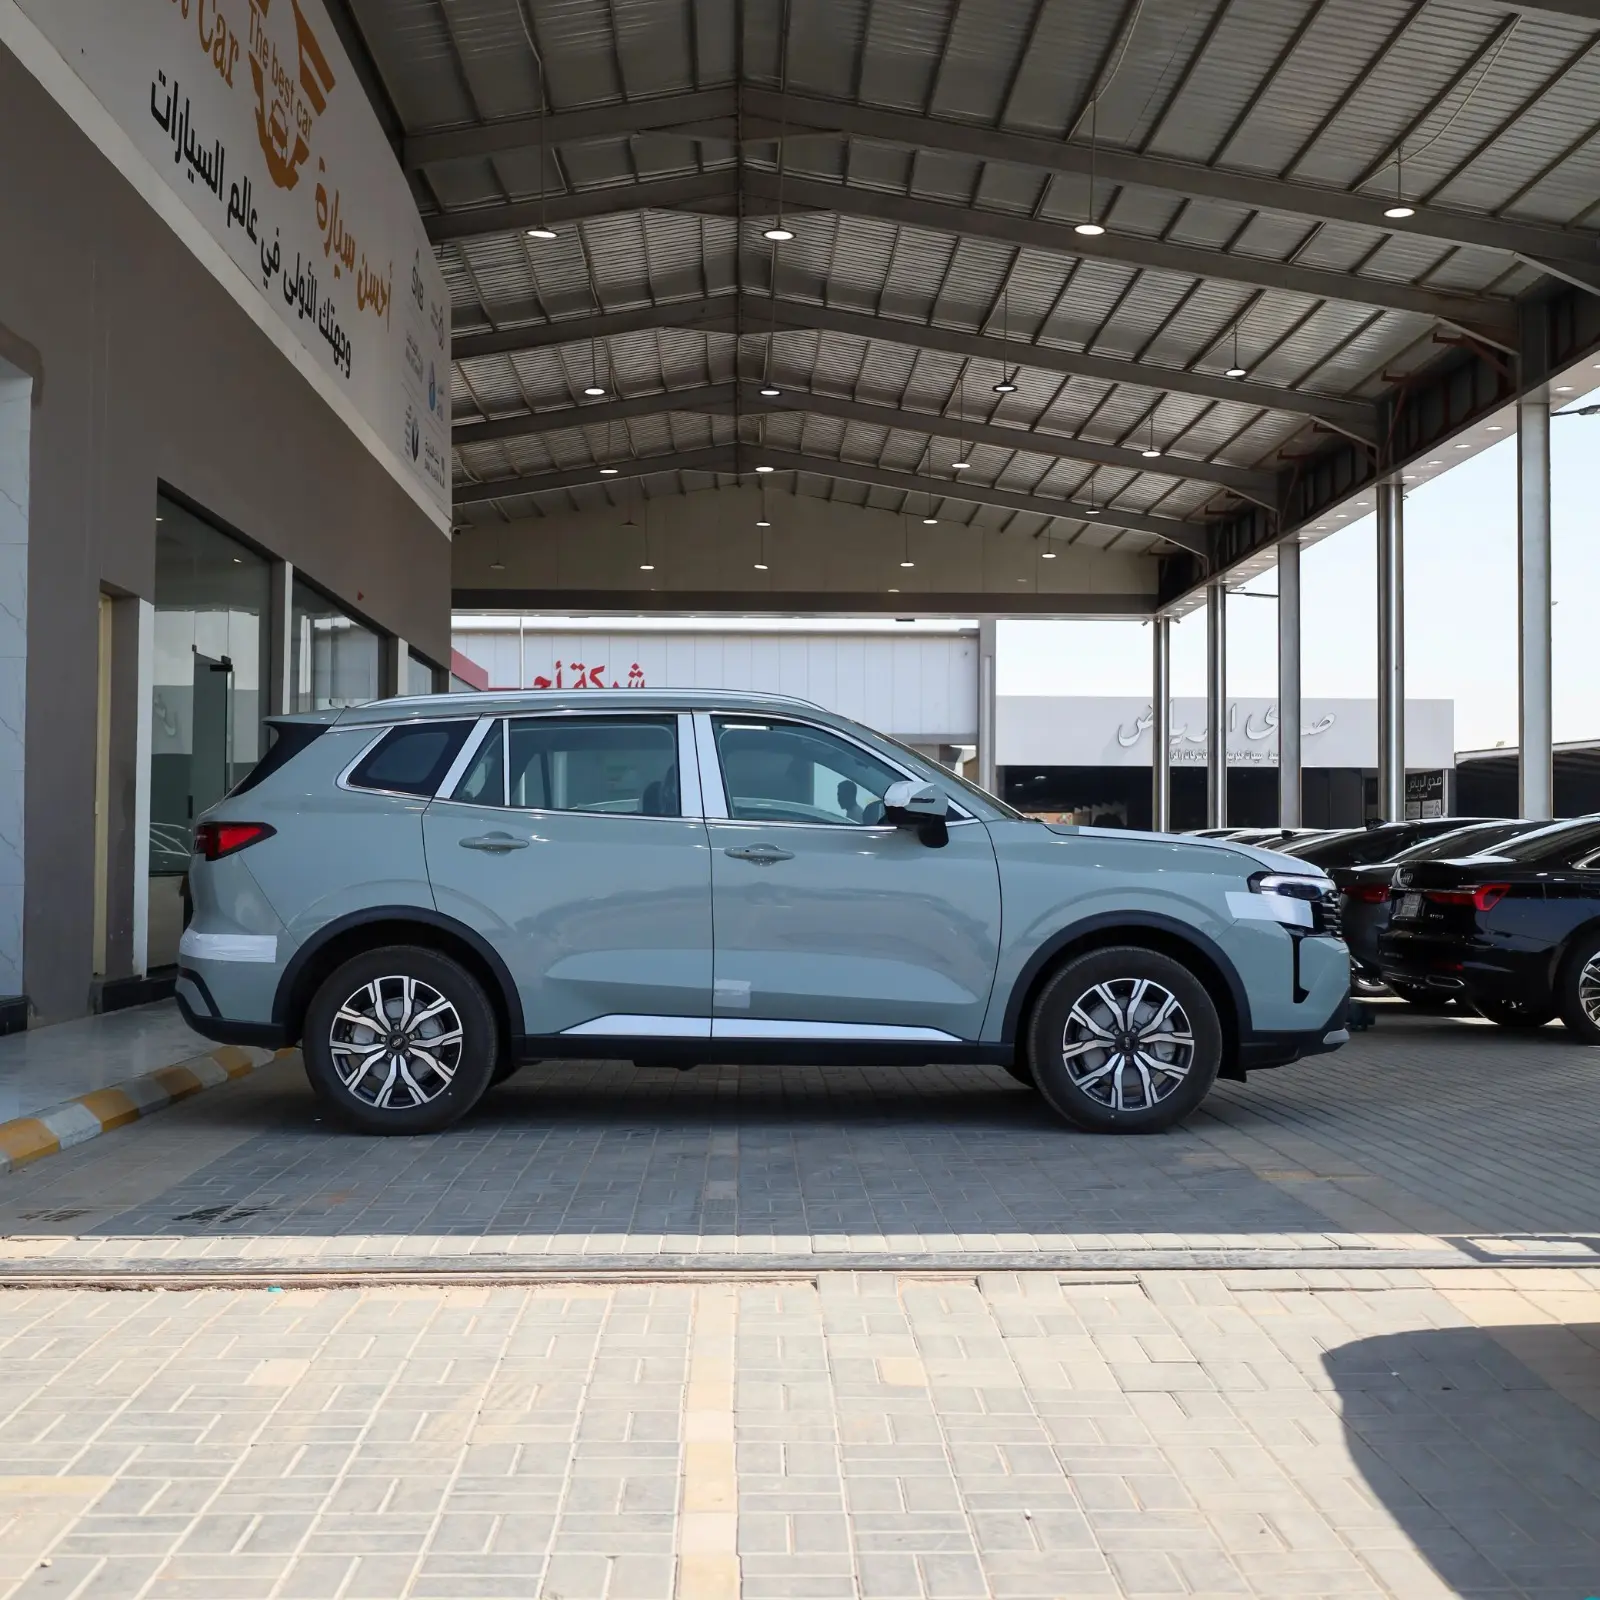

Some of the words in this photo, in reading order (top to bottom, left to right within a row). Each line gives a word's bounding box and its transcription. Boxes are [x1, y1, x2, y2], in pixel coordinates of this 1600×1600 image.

[199, 0, 239, 89] Car
[249, 0, 268, 69] The
[272, 42, 295, 115] best
[296, 99, 313, 141] car
[150, 69, 224, 202] السيارات
[227, 176, 258, 245] عالم
[314, 156, 355, 280] سيارة
[261, 227, 281, 289] في
[283, 252, 317, 324] الأولى
[356, 261, 392, 331] أحسن
[319, 297, 352, 379] وجهتك
[570, 662, 645, 688] شكة
